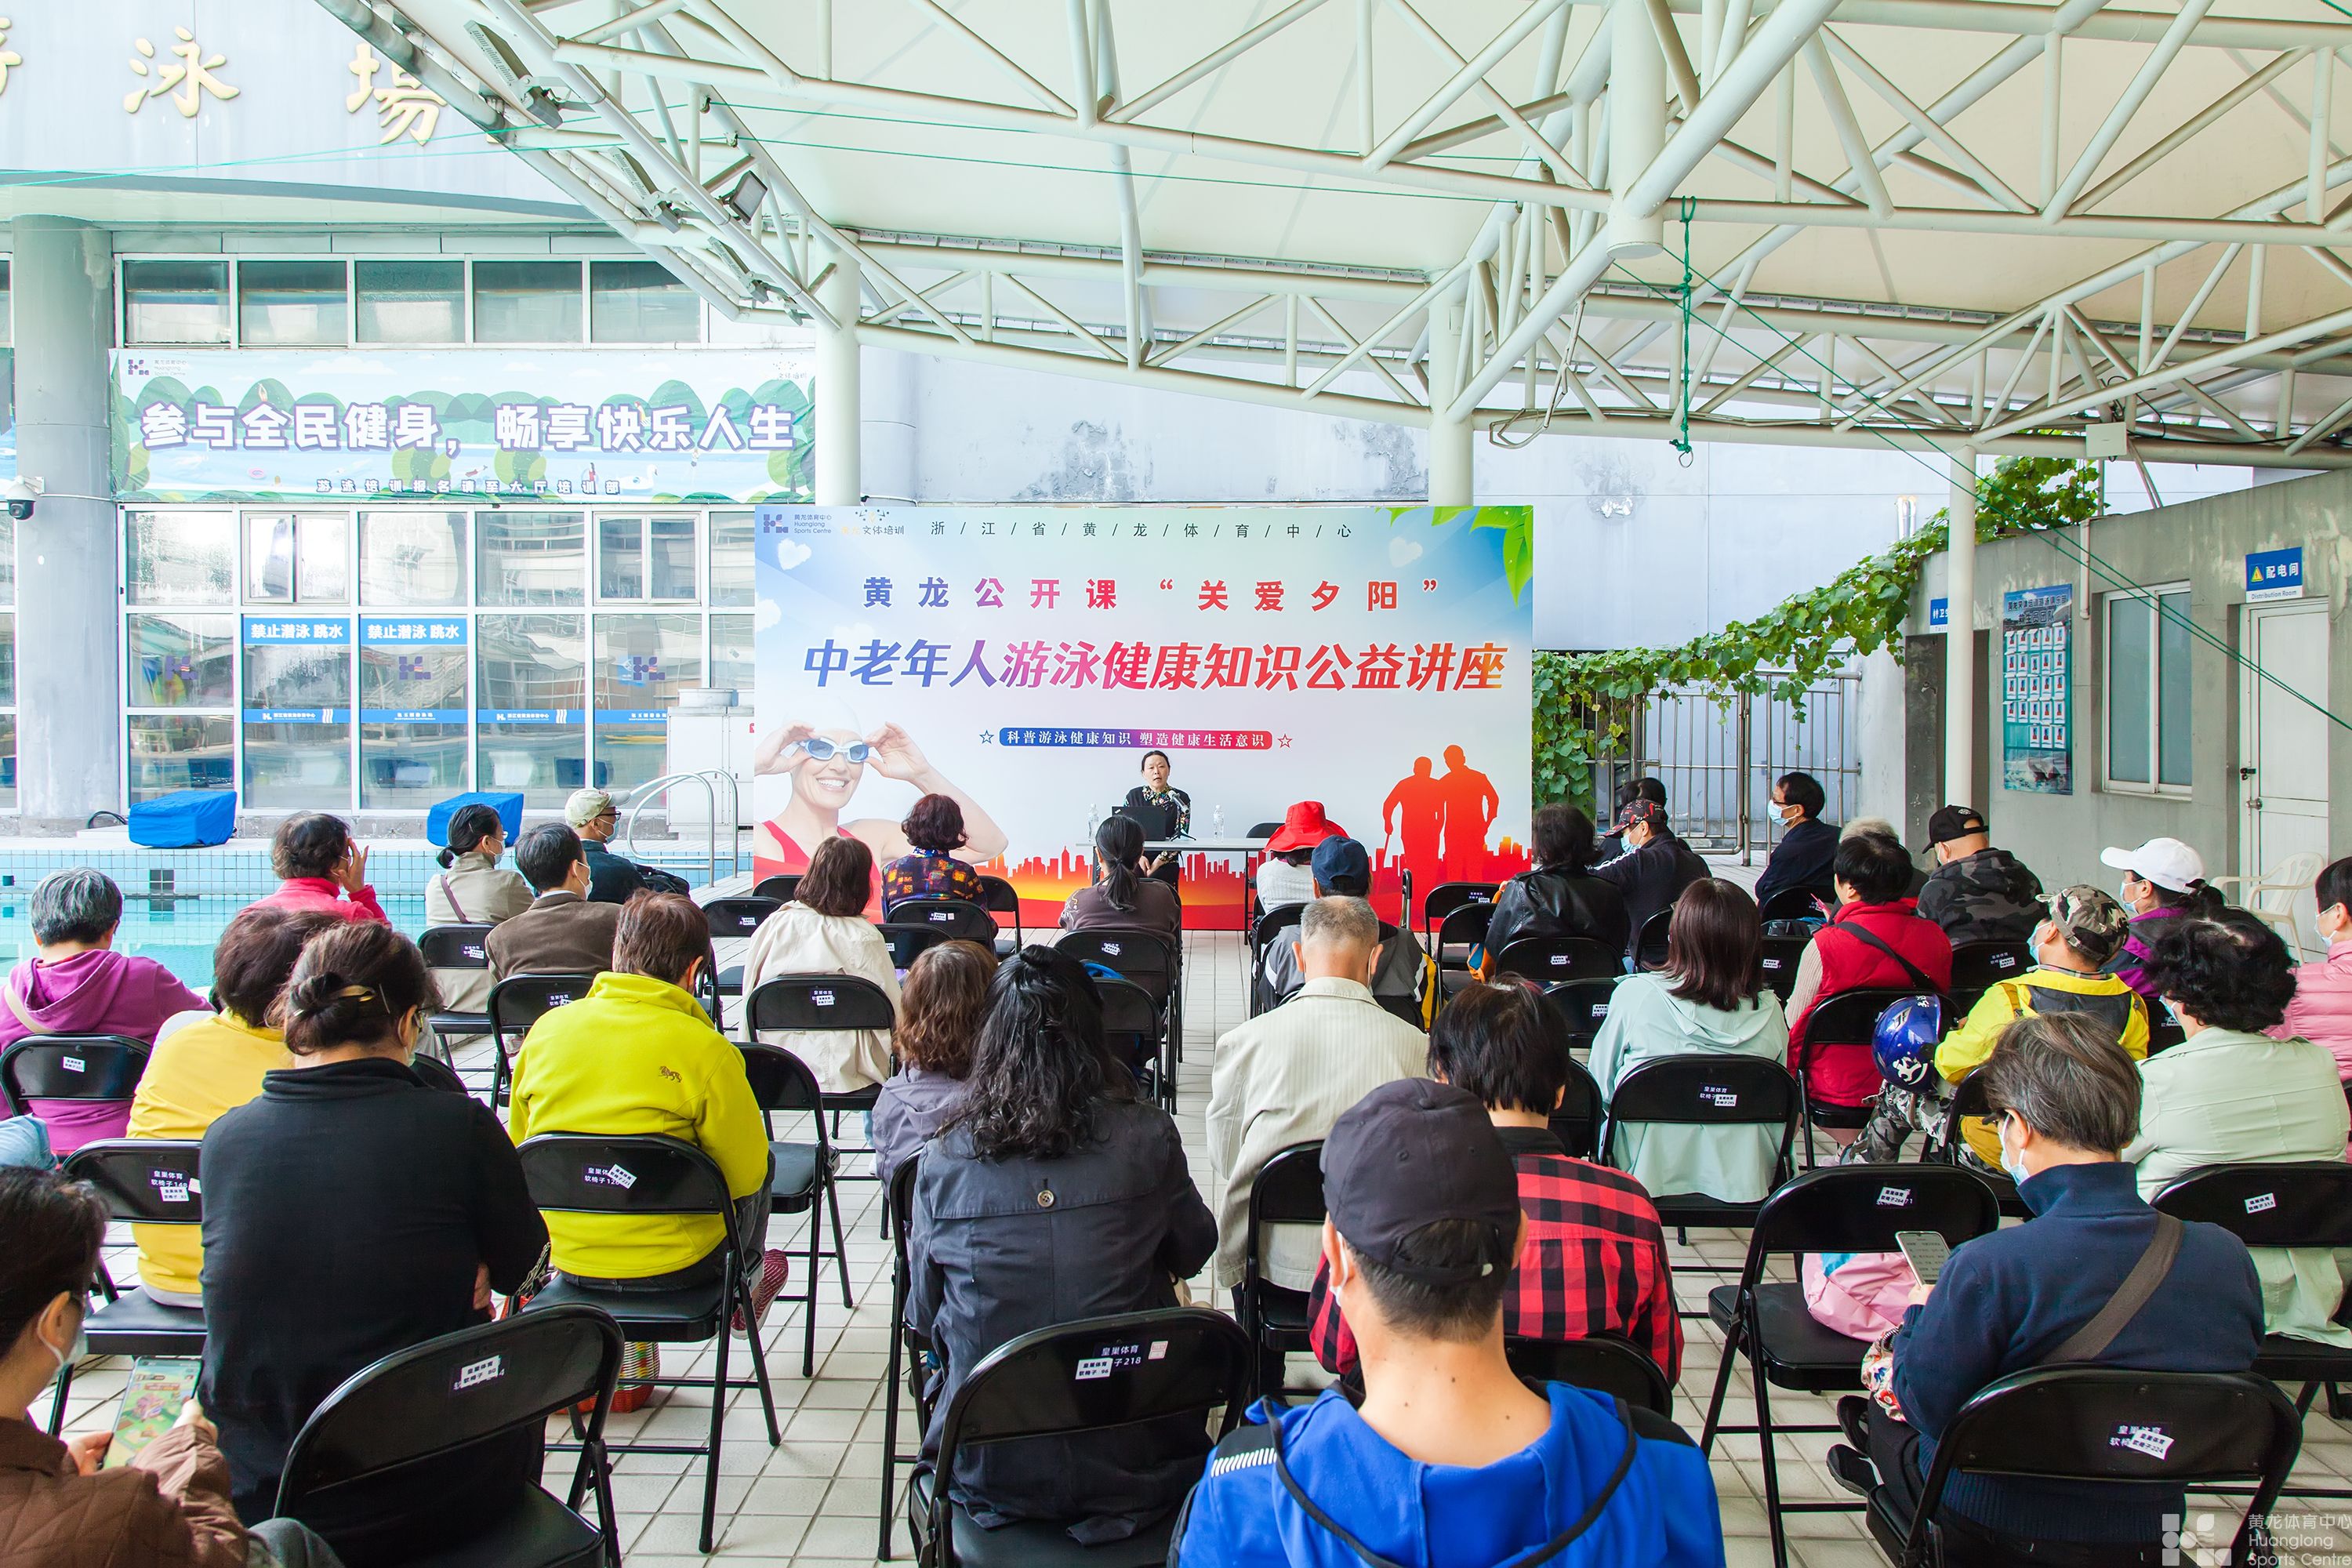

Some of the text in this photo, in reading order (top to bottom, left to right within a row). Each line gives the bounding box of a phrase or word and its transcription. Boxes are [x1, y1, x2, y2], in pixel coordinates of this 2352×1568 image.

[316, 478, 621, 495] 游泳培训报名请至大厅培训部
[2266, 562, 2299, 579] 配电间
[2251, 591, 2281, 600] Distribution
[251, 624, 343, 639] 禁止潜泳 跳水
[367, 624, 459, 639] 禁止潜泳 跳水
[804, 637, 1508, 691] 中老年人游泳健康知识公益讲座
[1007, 730, 1265, 748] 科普游泳健康知识 塑造健康生活意识
[1101, 1345, 1139, 1356] 皇巢体育
[1114, 1356, 1142, 1367] 子218
